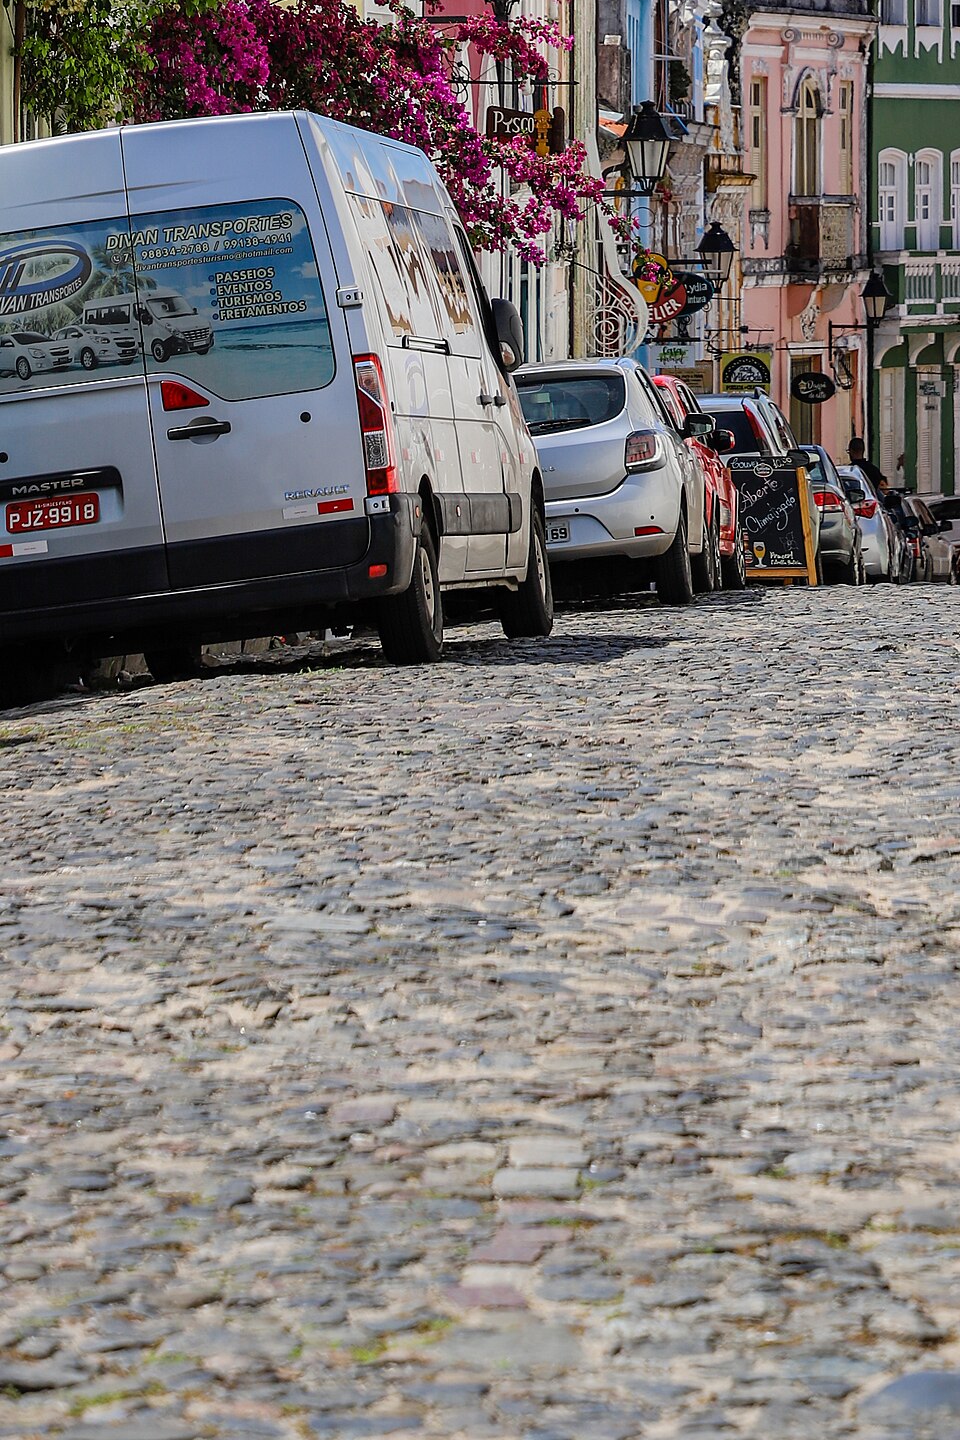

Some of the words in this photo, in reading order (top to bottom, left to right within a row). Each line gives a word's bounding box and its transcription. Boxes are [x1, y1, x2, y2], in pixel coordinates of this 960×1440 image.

[106, 229, 158, 250] DIVAN
[164, 213, 293, 243] TRANSPORTES
[141, 243, 209, 260] 98834-2788
[223, 233, 292, 249] 99138-4941
[134, 247, 293, 272] divantransportesturismo@hotmail.com
[215, 267, 275, 283] PASSEIOS
[30, 277, 83, 308] TRANSPORTES
[217, 280, 272, 296] EVENTOS
[217, 291, 282, 308] TURISMOS
[687, 296, 706, 304] intura
[219, 301, 307, 320] FRETAMENTOS
[12, 479, 84, 495] MASTER
[284, 484, 350, 501] RENAULT
